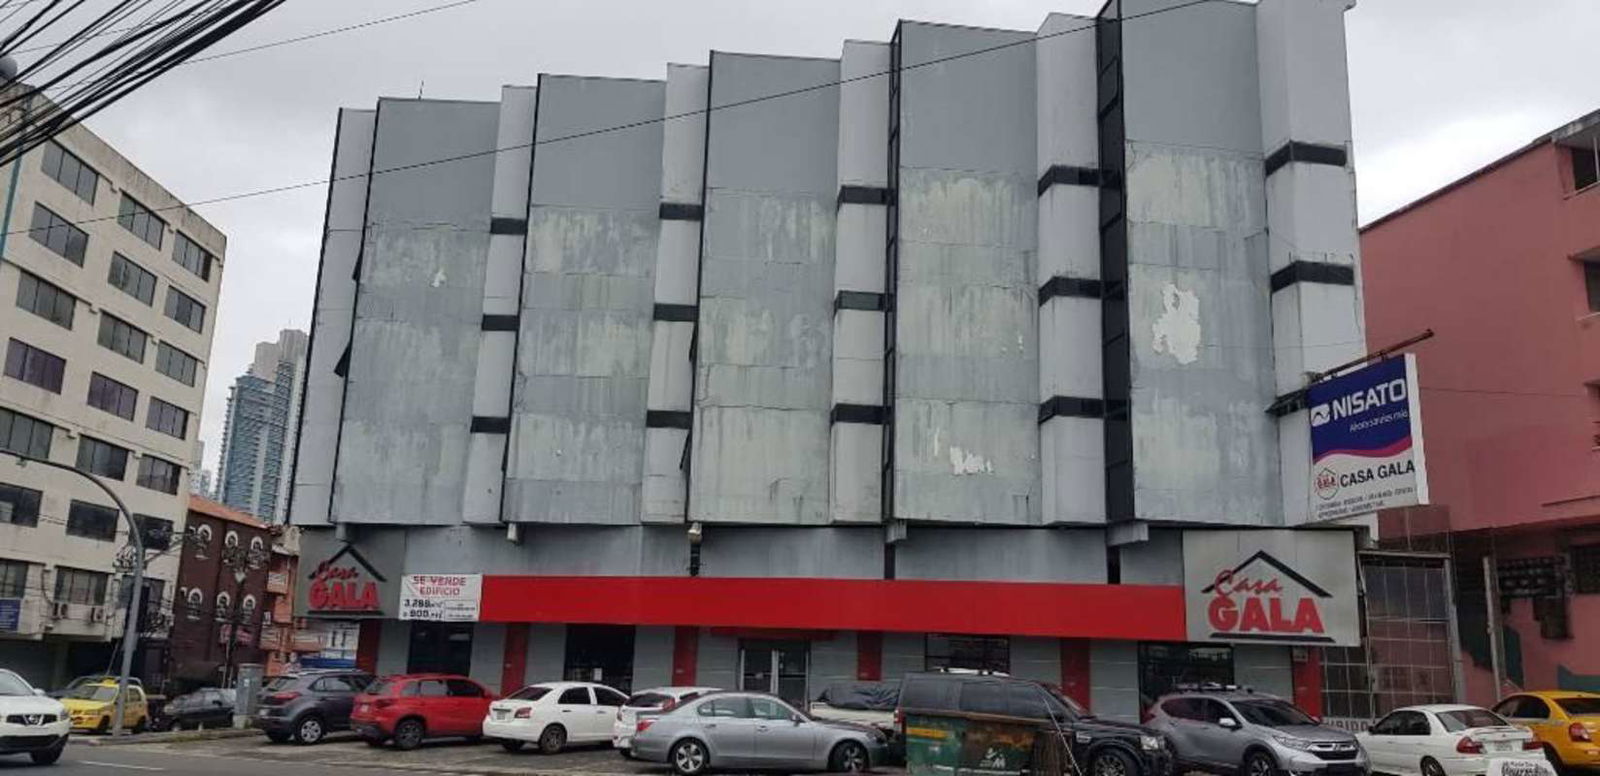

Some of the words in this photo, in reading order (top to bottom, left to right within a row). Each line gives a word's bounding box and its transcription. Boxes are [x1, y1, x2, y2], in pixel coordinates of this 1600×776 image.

[1332, 378, 1406, 420] NISATO
[1340, 469, 1374, 488] CASA
[1377, 460, 1415, 479] GALA
[309, 580, 378, 609] GALA
[413, 575, 425, 585] SE
[430, 575, 467, 586] VENDE
[420, 586, 460, 596] EDIFICIO
[1215, 570, 1283, 596] Casa
[1208, 596, 1325, 633] GALA
